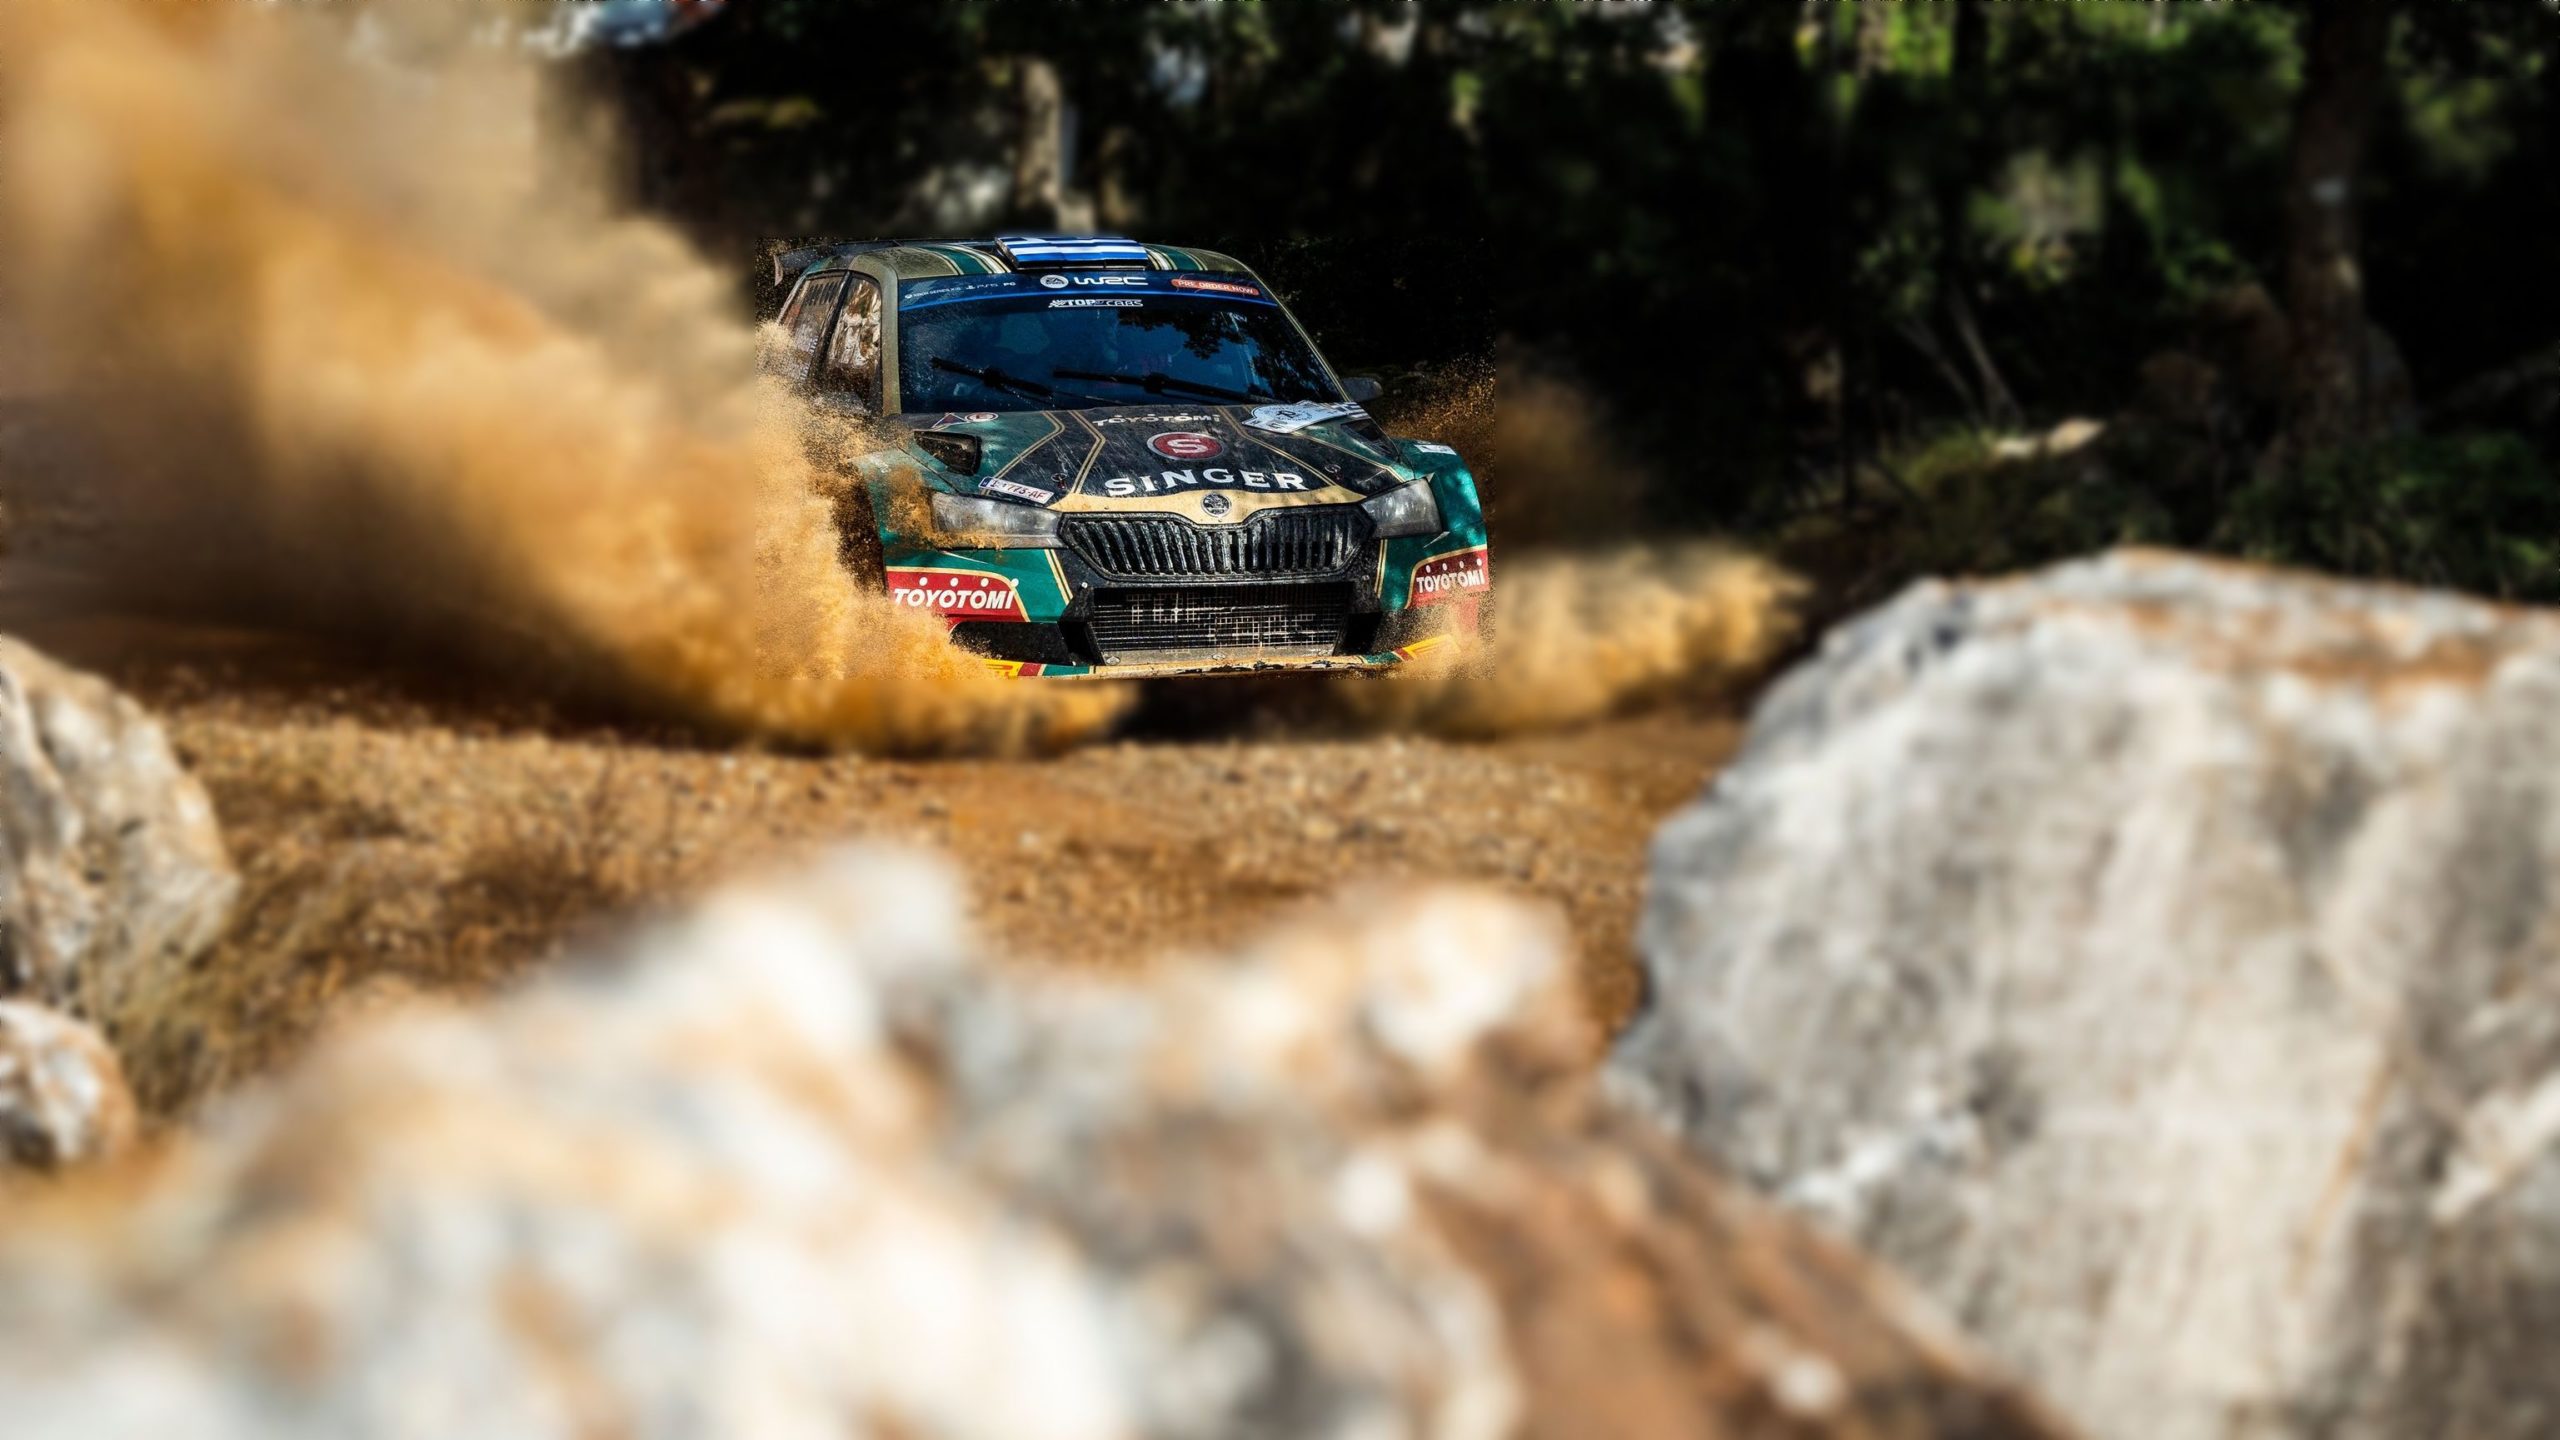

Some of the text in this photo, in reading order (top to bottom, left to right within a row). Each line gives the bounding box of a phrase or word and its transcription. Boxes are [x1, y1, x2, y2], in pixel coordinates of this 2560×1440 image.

[1073, 276, 1149, 286] WRC
[1178, 280, 1254, 295] PRE ORDER NOW
[1064, 298, 1096, 307] TOP
[1166, 438, 1209, 454] S
[1104, 468, 1310, 497] SINGER
[1416, 558, 1486, 593] TOYOTOMI
[893, 577, 1019, 610] TOYOTOMI
